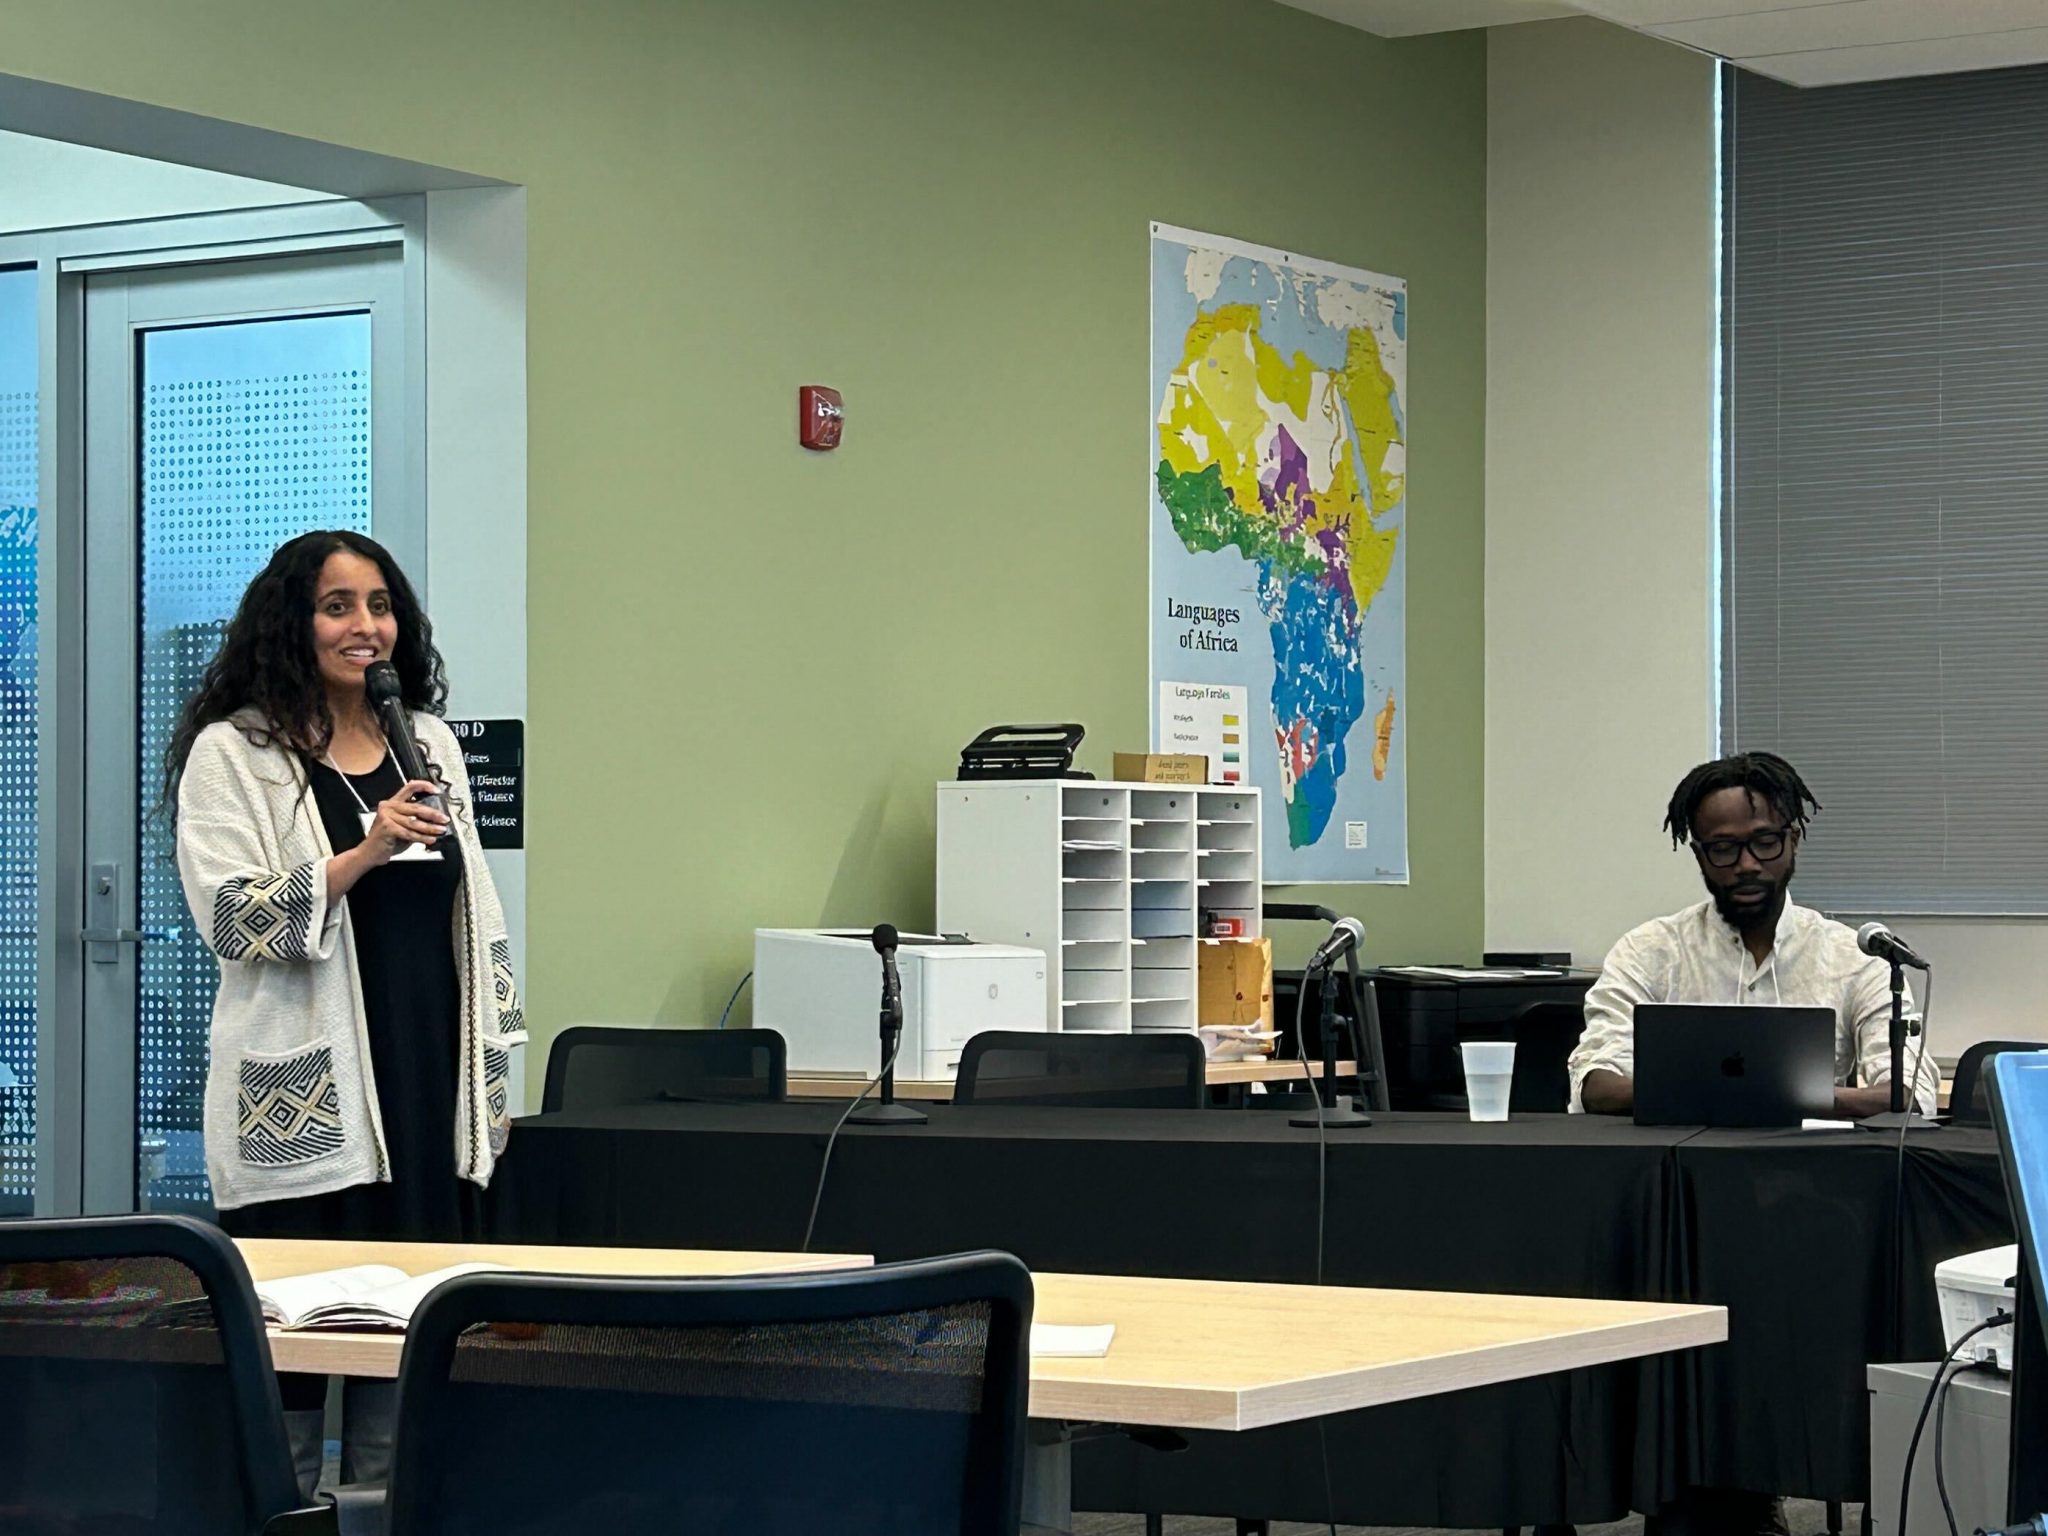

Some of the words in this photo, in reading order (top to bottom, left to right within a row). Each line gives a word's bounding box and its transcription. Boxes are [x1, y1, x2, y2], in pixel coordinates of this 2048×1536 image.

[1168, 598, 1240, 627] Languages
[1180, 629, 1194, 648] of
[1196, 630, 1238, 652] Africa
[473, 721, 485, 738] D
[477, 774, 517, 787] Director
